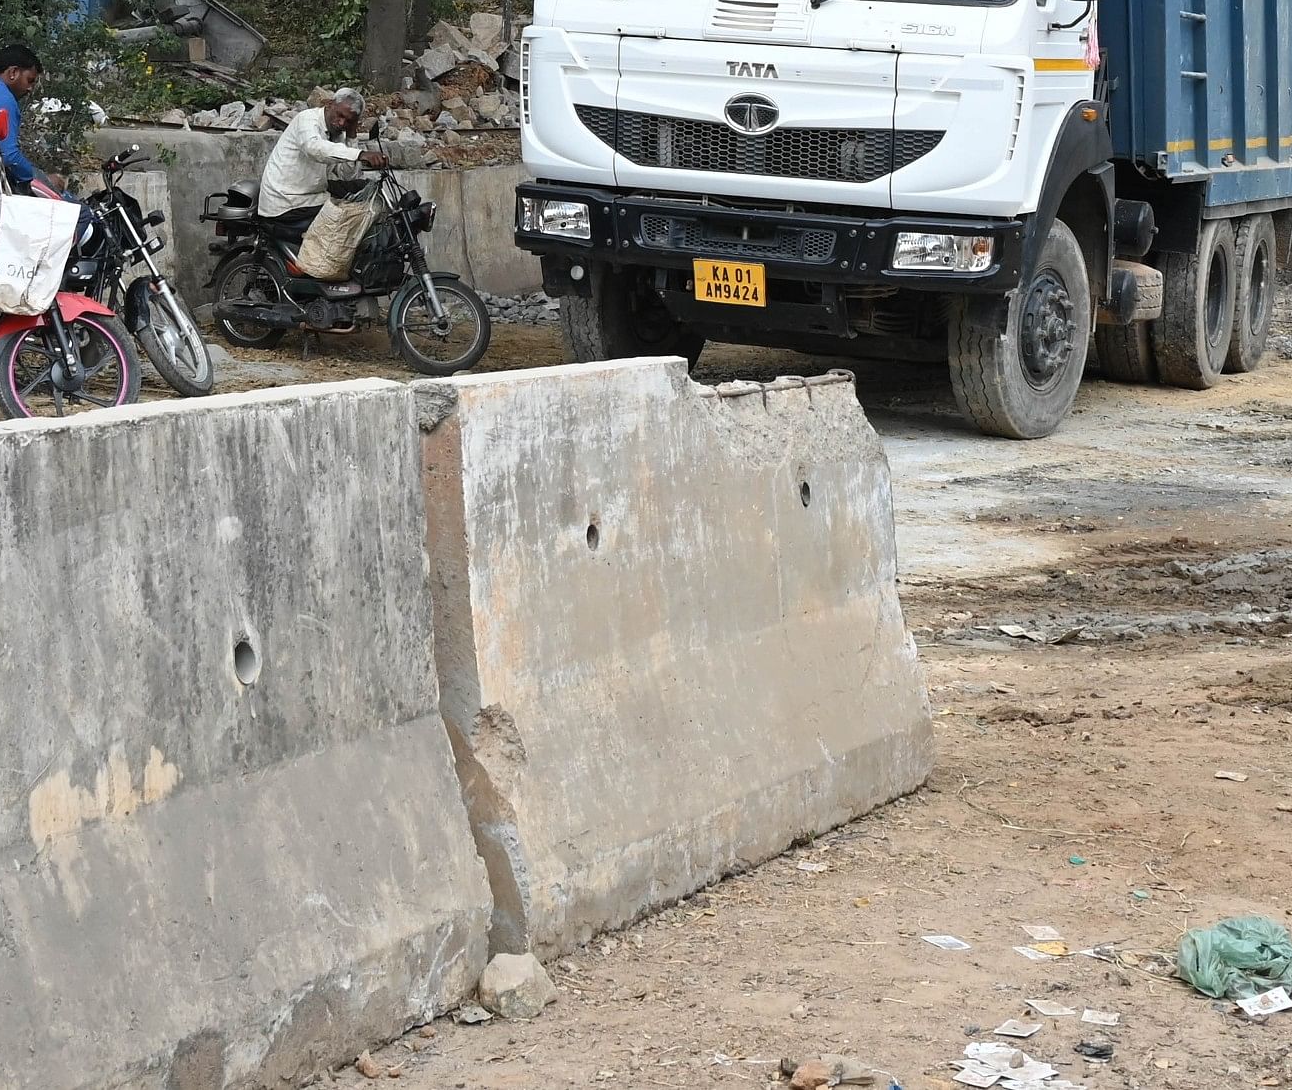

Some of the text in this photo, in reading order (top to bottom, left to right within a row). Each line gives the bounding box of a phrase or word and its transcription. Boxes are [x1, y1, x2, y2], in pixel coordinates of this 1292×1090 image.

[726, 60, 779, 79] TATA
[7, 263, 36, 279] PVC
[712, 265, 751, 284] KA 01
[705, 282, 759, 302] AM9424
